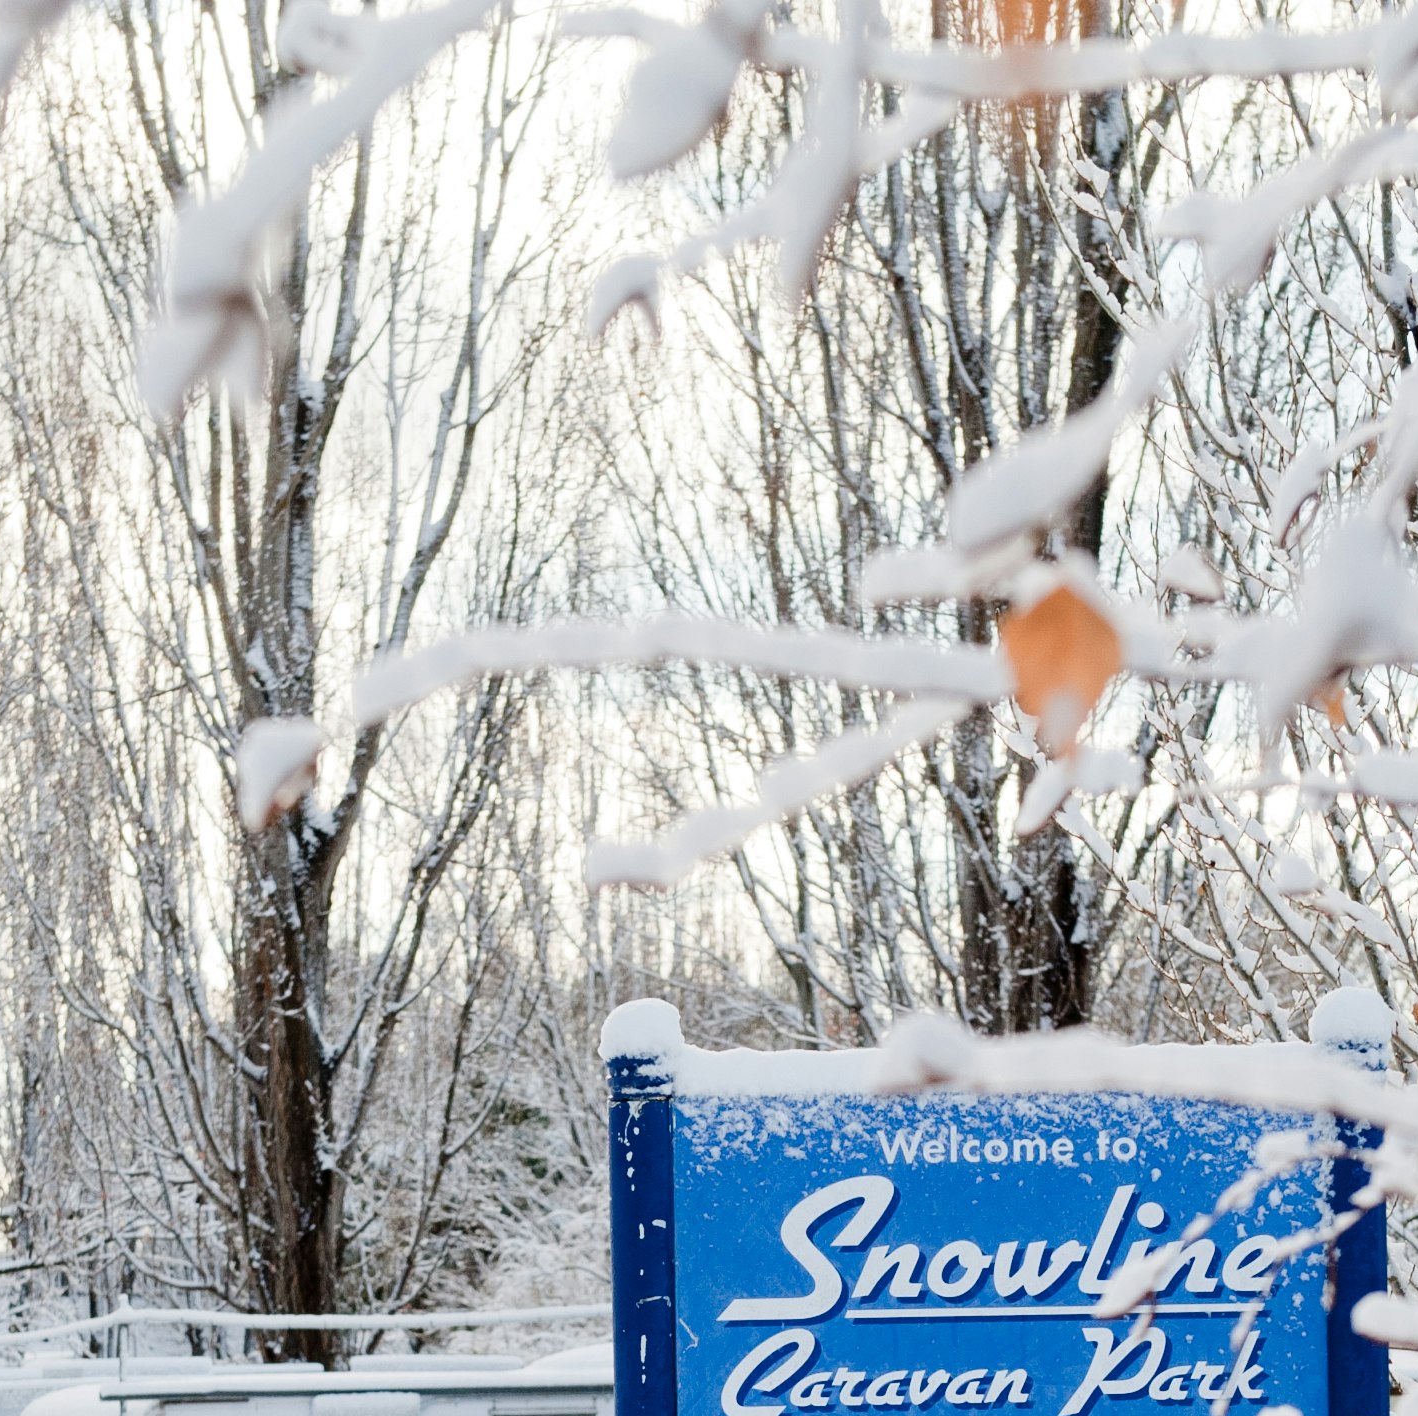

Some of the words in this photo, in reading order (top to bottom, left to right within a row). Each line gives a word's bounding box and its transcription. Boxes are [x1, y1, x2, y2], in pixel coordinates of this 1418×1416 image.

[877, 1126, 1075, 1164] Welcome
[1096, 1130, 1138, 1161] to
[716, 1174, 1279, 1322] Snowline
